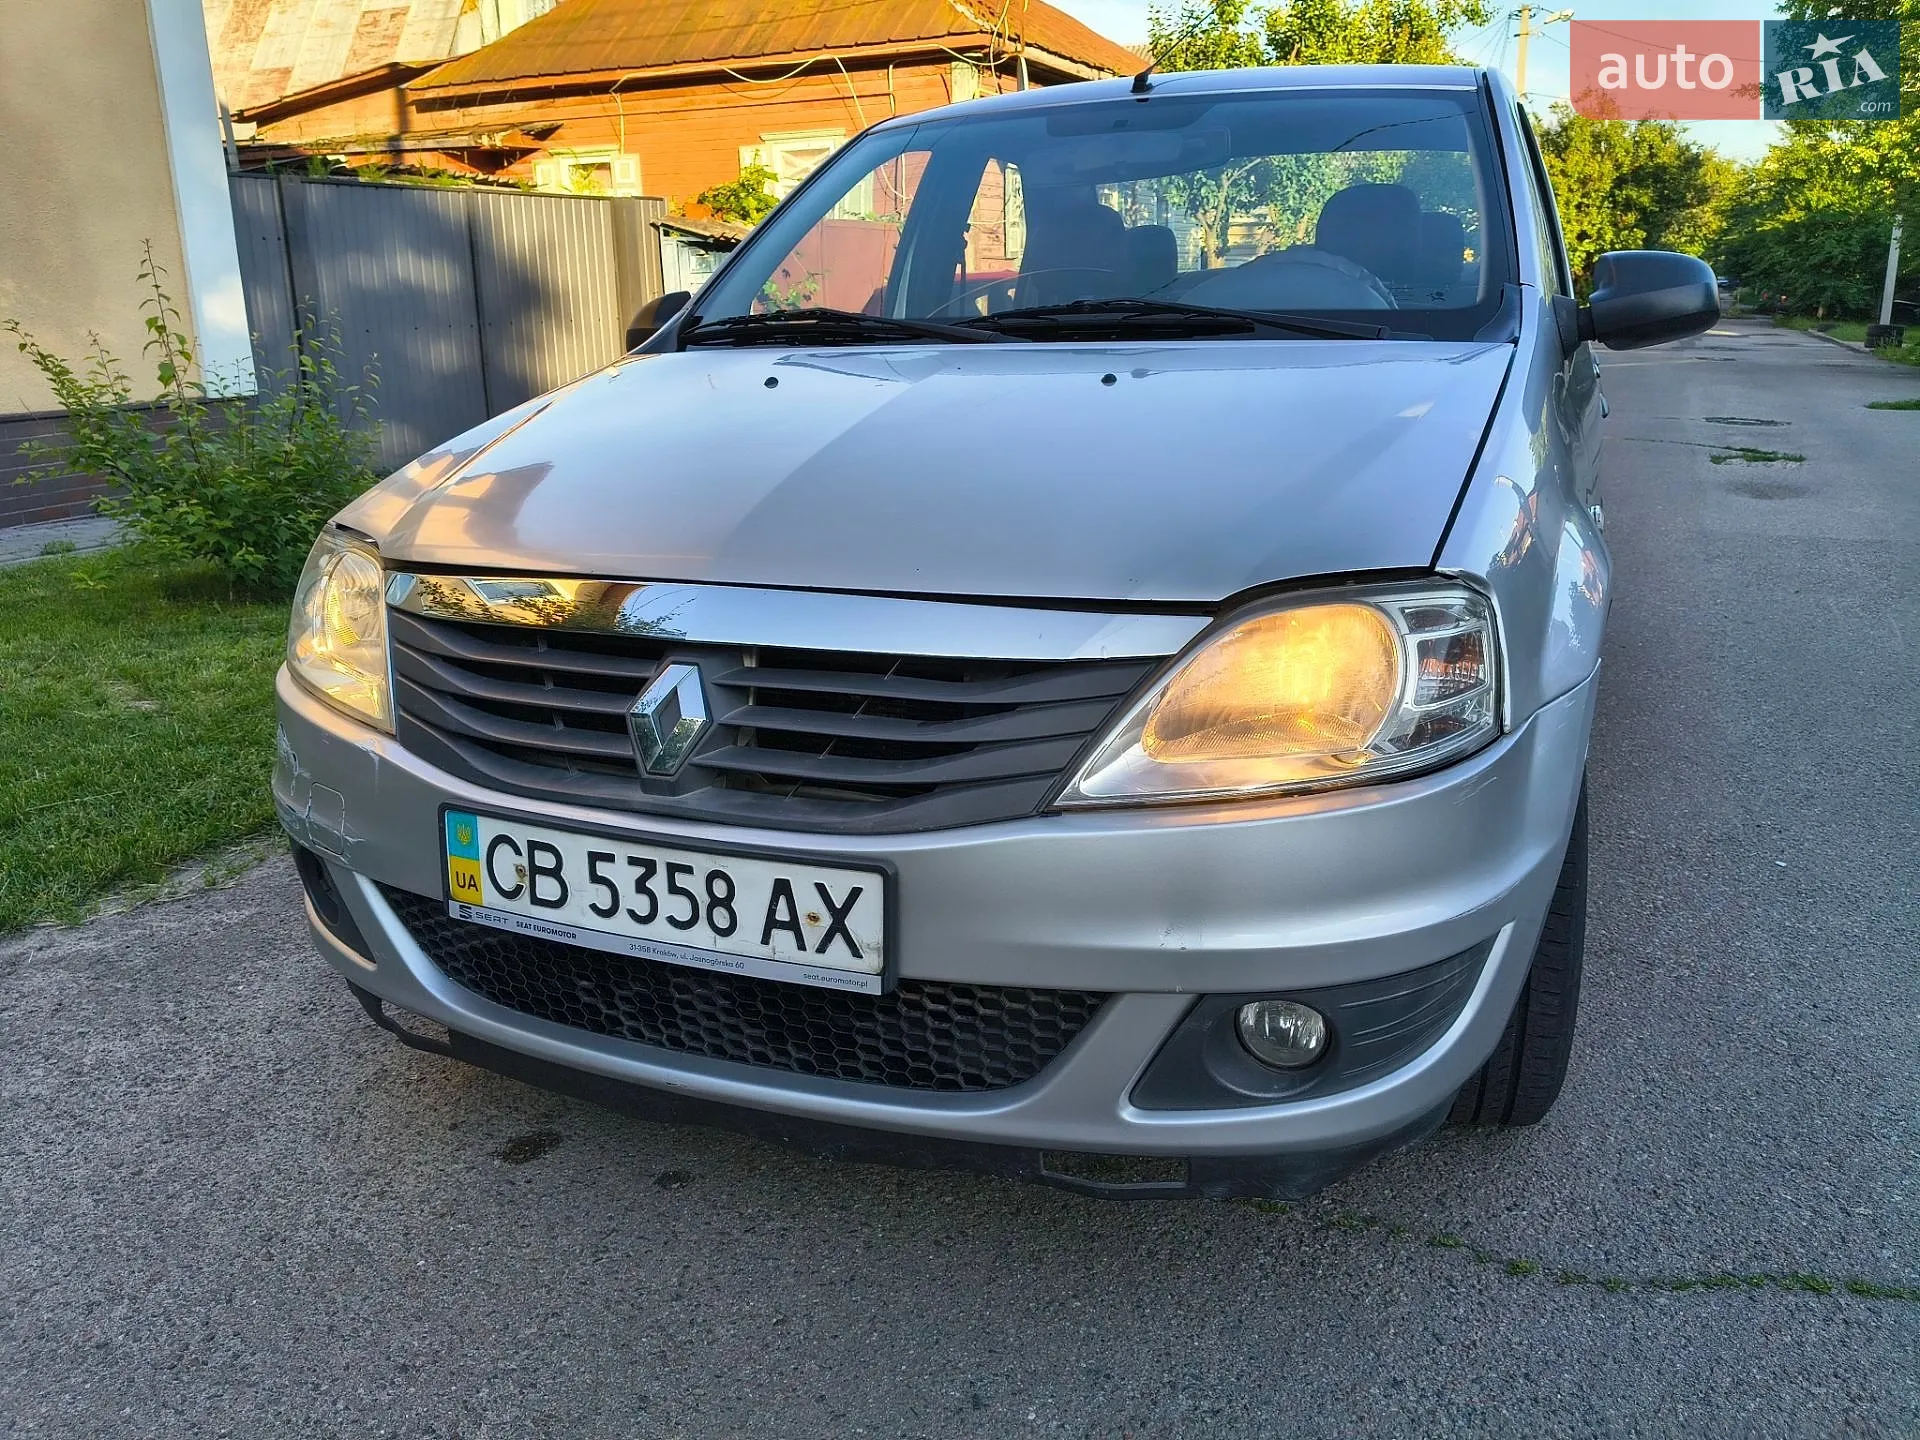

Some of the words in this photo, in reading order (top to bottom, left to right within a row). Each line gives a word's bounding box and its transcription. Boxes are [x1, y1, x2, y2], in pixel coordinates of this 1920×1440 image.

[455, 871, 479, 893] UA
[587, 850, 737, 938] 5358
[760, 877, 864, 959] AX
[475, 911, 509, 925] SEAT
[516, 920, 532, 931] SEAT
[533, 923, 577, 940] EUROMOTOR
[734, 961, 745, 970] 60
